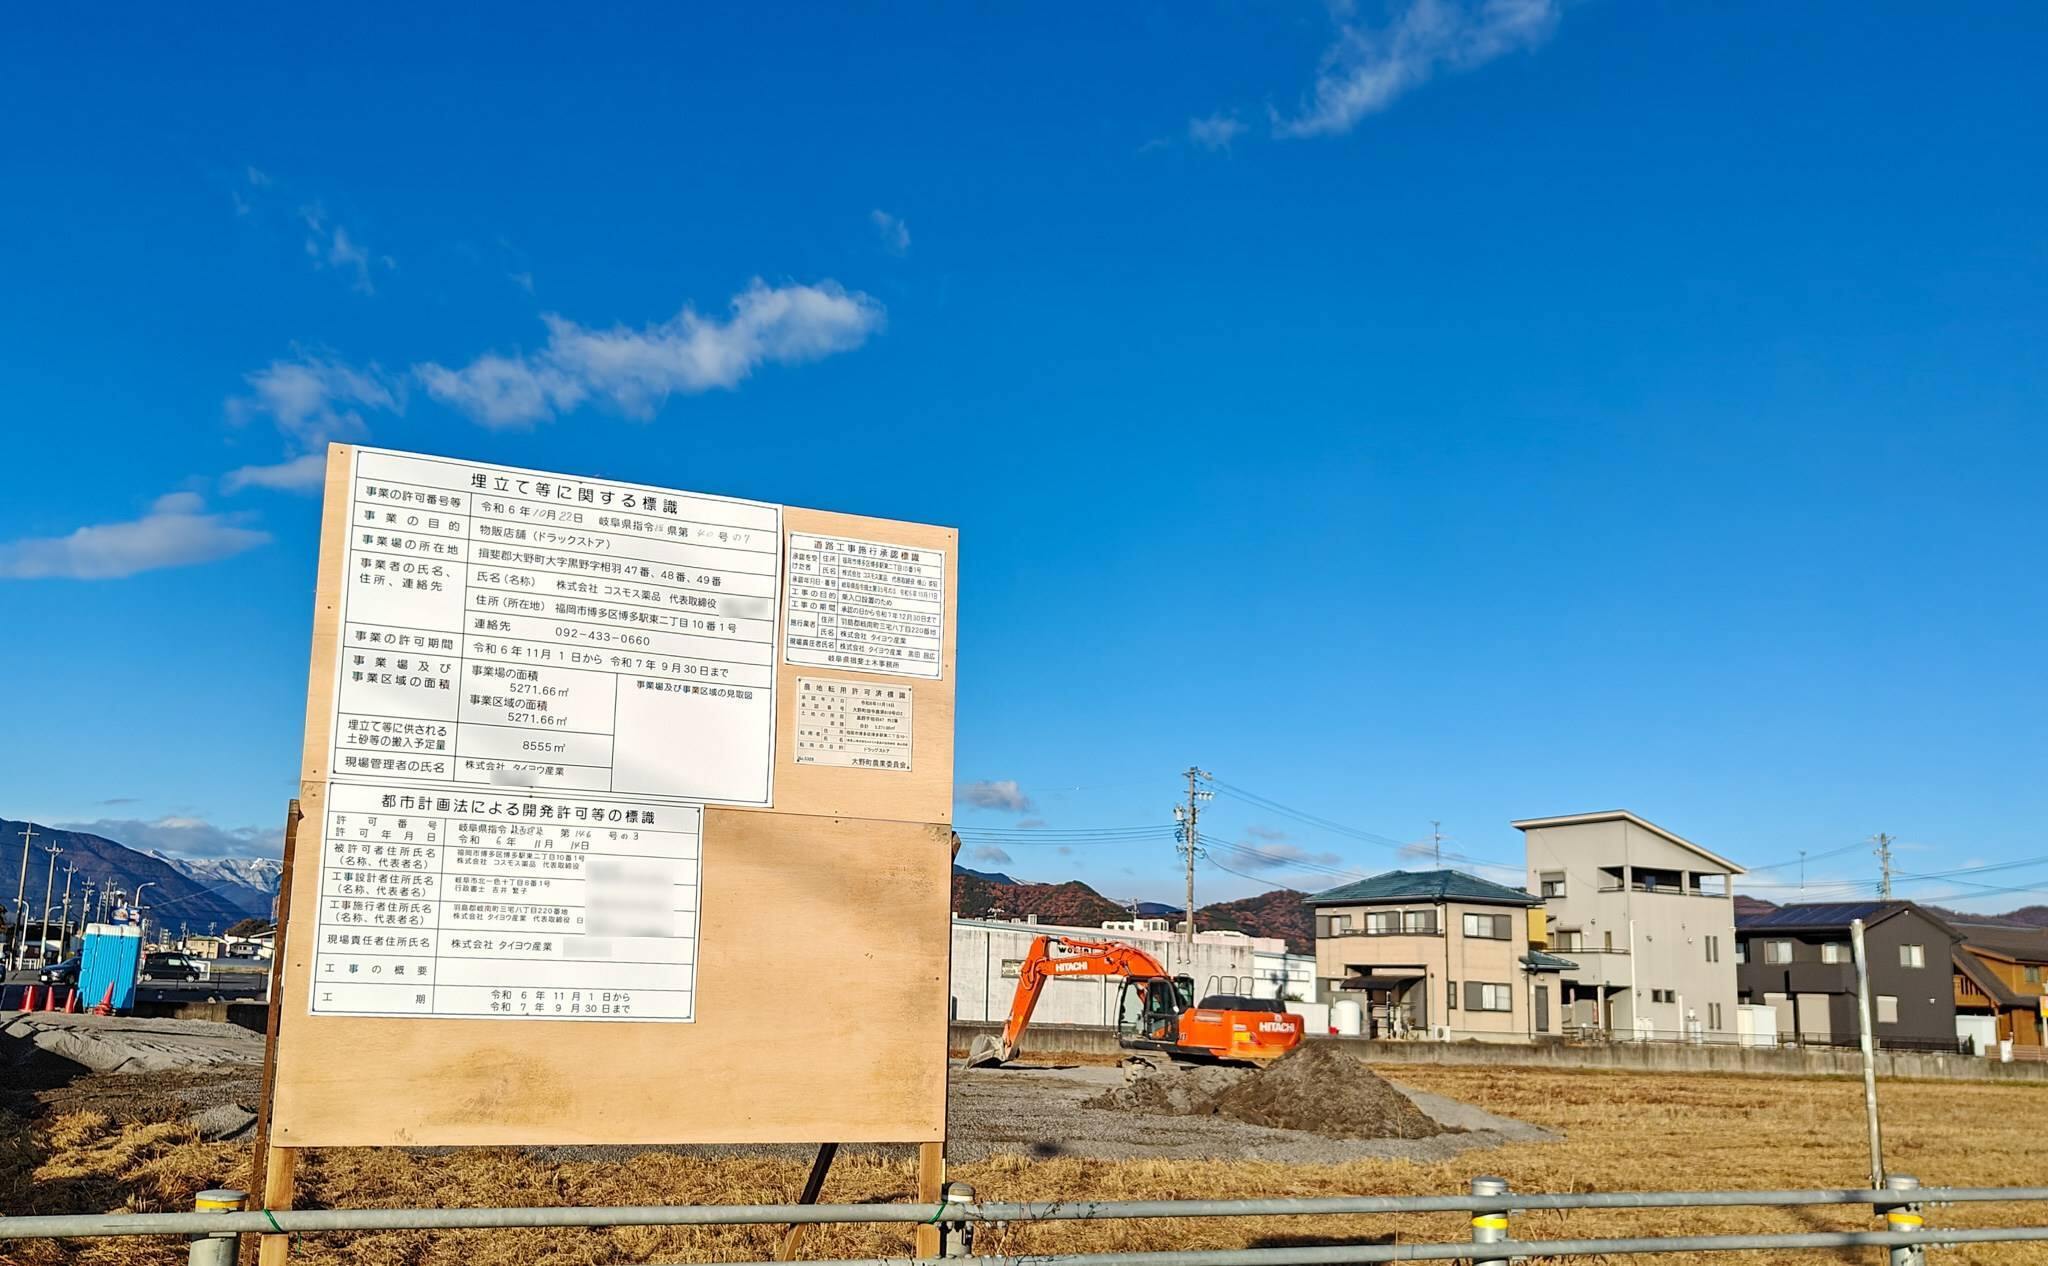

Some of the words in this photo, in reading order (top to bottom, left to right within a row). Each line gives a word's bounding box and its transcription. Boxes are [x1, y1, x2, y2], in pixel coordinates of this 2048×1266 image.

[365, 485, 462, 508] 事業の許可番号等
[471, 473, 678, 514] 埋立て等に関する標識
[364, 510, 460, 532] 事業の目的
[363, 534, 459, 555] 事業場の所在地
[360, 557, 452, 577] 事業者の氏名、
[360, 573, 443, 592] 住所、連絡先
[556, 580, 598, 594] 株式会社
[604, 586, 661, 602] コスモス薬品
[669, 594, 717, 609] 代表取締役
[355, 631, 453, 650] 事業の許可期間
[474, 618, 511, 631] 連絡先
[555, 627, 650, 646] 092-433-0660
[353, 655, 451, 673] 事業場及び
[473, 641, 603, 665] 令和6年11月1日から
[610, 655, 729, 677] 令和7年9月30日まで
[352, 671, 450, 690] 事業区域の面積
[472, 665, 538, 681] 事業場の面積
[637, 680, 753, 700] 事業場及び事業区域の見取図
[470, 694, 548, 711] 事業区域の面積
[348, 719, 447, 737] 埋立て等に供される
[346, 734, 446, 751] 土砂等の搬入予定量
[345, 756, 445, 774] 現場管理者の氏名
[465, 760, 504, 770] 株式会社
[382, 794, 655, 824] 都市計画法による開発許可等の標識
[336, 815, 437, 829] 許可番号
[335, 827, 436, 841] 許可年月日
[334, 843, 436, 858] 被許可者住所氏名
[457, 857, 487, 866] 株式会社
[493, 859, 536, 868] コスモス薬品
[542, 861, 579, 870] 代表取締役
[332, 872, 434, 885] 工事設計者住所氏名
[330, 900, 432, 914] 工事施行者住所氏名
[453, 912, 483, 920] 株式会社
[487, 913, 526, 921] タイヨウ産業
[533, 915, 570, 924] 代表取締役
[327, 934, 430, 948] 現場責任者住所氏名
[451, 939, 493, 950] 株式会社
[498, 941, 552, 952] タイヨウ産業
[325, 963, 427, 976] 工事の概要
[1055, 961, 1088, 972] HITACHI
[1259, 1022, 1295, 1032] HITACHI
